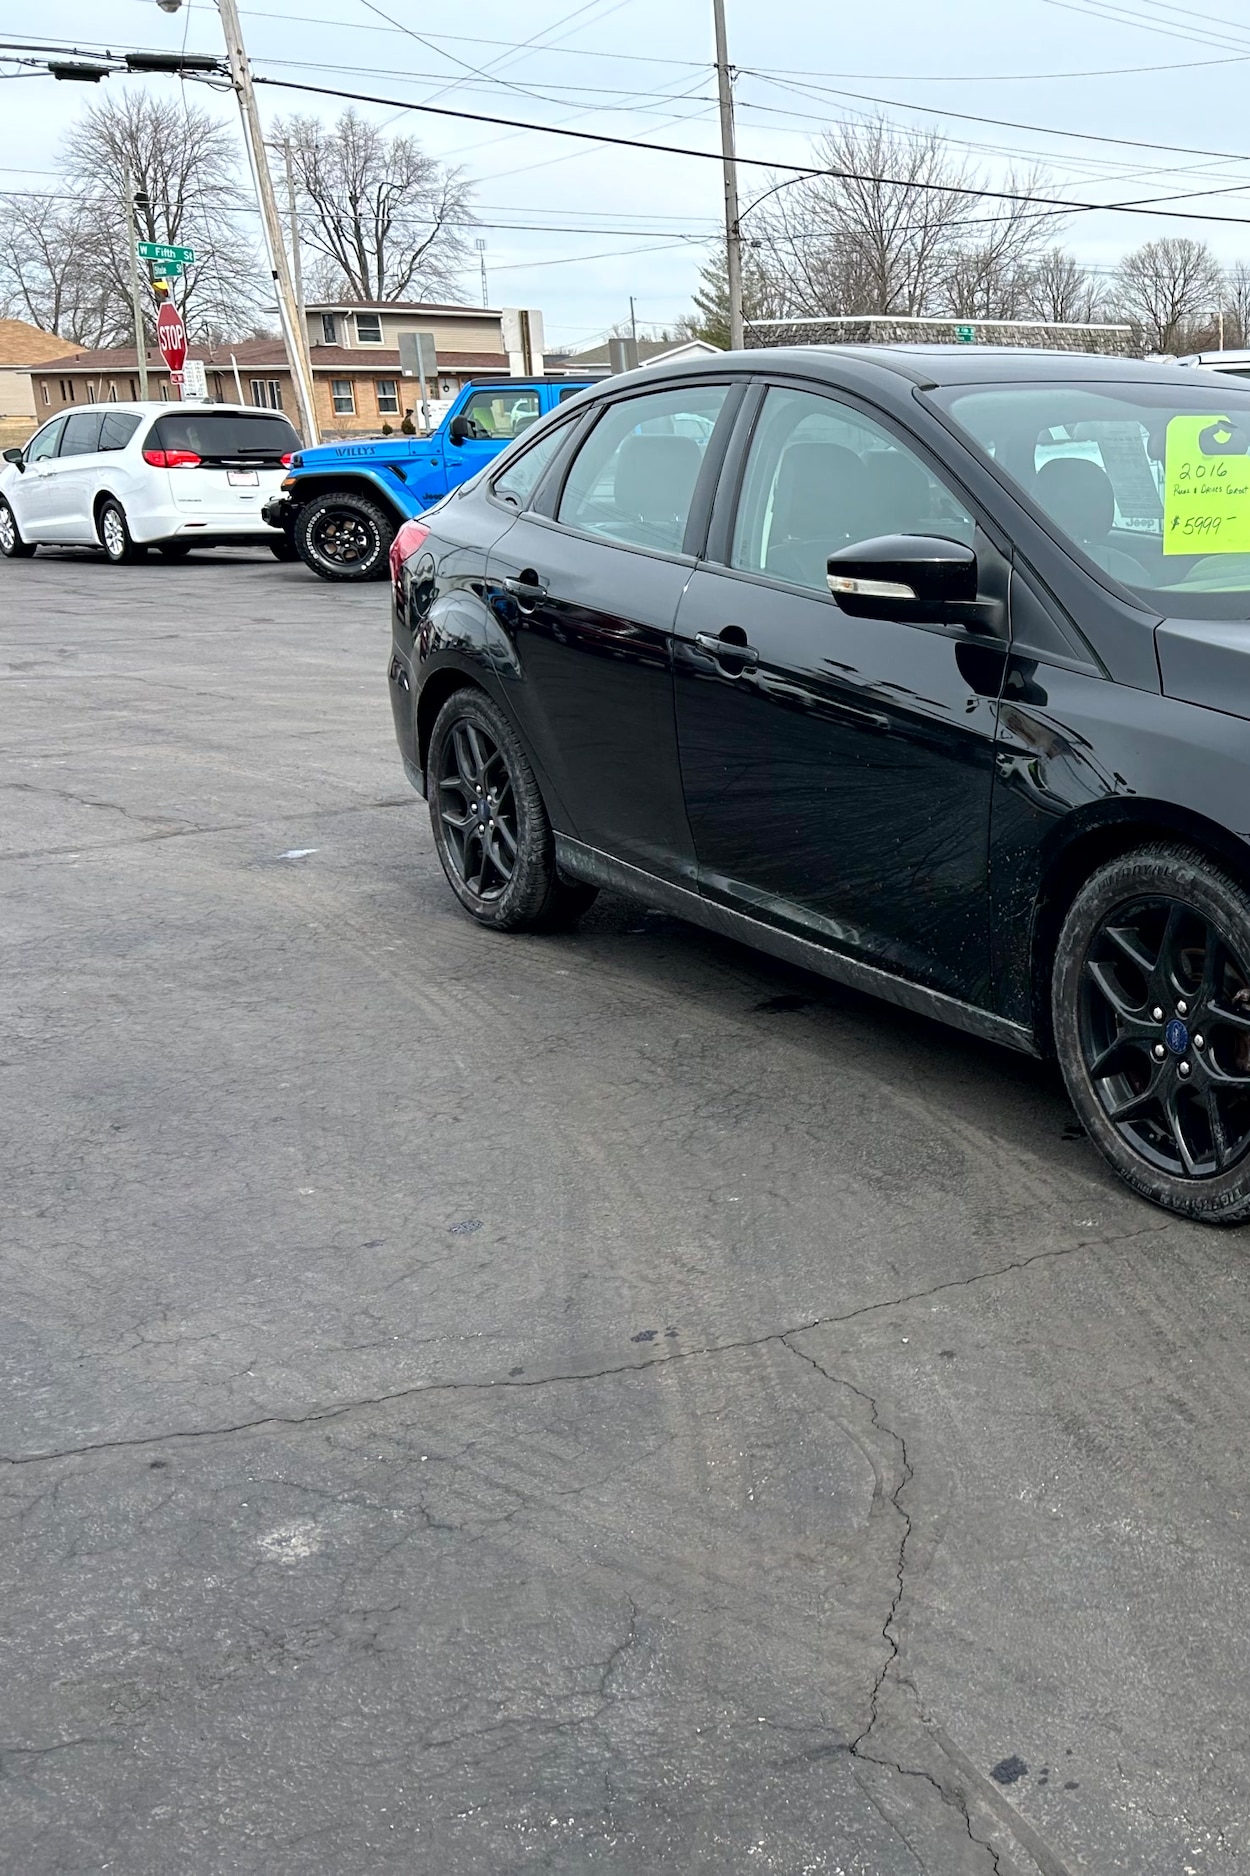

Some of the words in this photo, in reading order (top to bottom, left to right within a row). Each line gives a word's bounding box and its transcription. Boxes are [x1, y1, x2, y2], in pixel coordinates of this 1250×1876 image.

[140, 245, 148, 255] W
[155, 247, 176, 258] Fifth
[183, 251, 193, 260] St
[160, 325, 183, 351] STOP
[335, 446, 376, 457] WILLYS
[1179, 462, 1228, 480] 2016
[1126, 517, 1155, 528] Jeep
